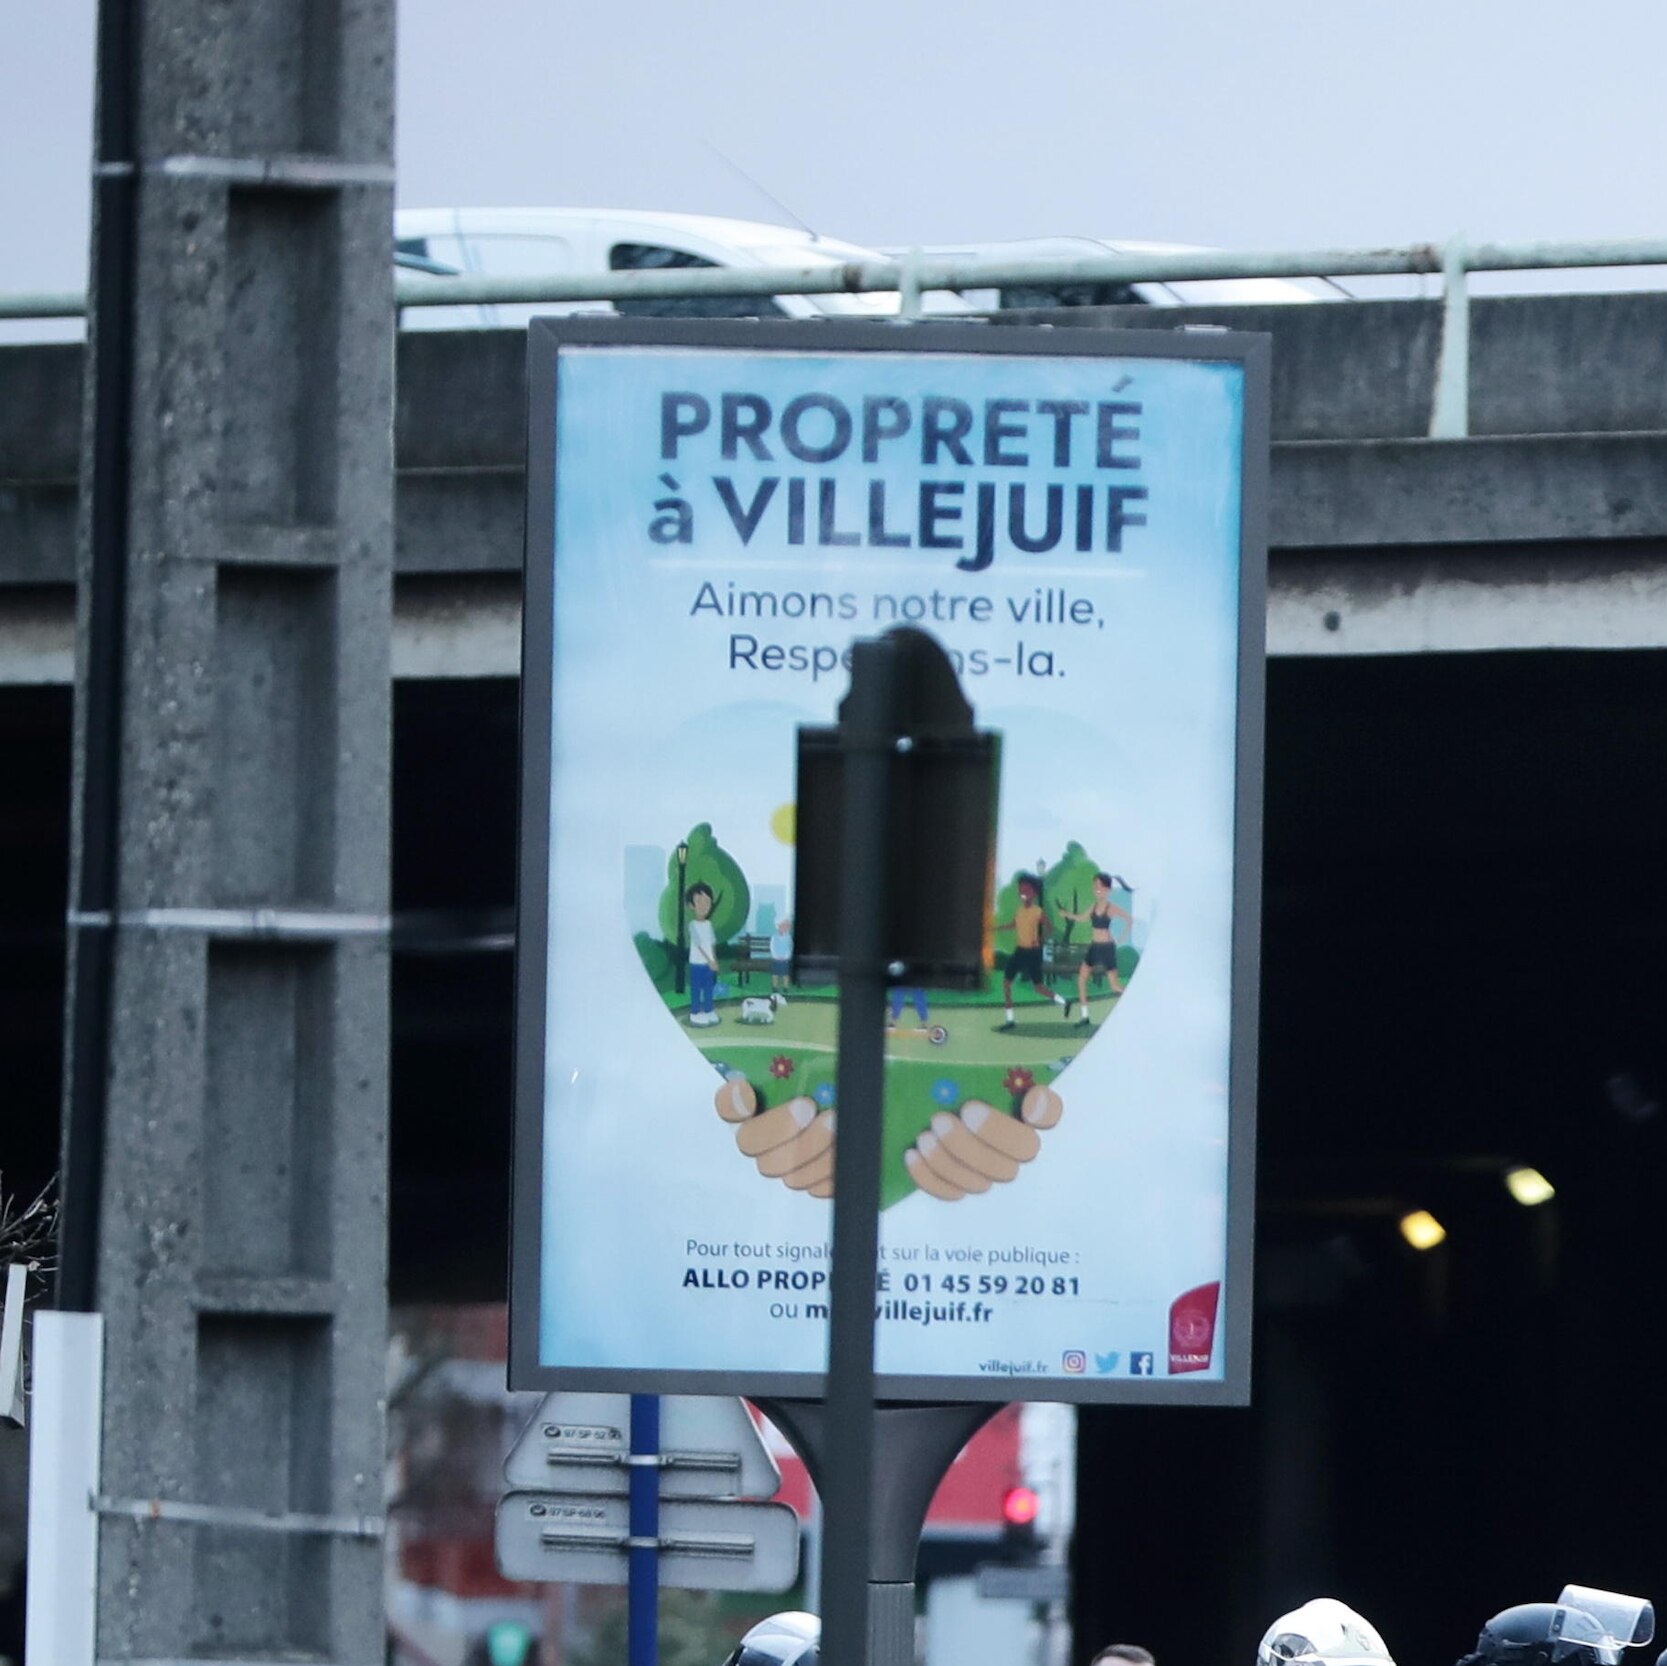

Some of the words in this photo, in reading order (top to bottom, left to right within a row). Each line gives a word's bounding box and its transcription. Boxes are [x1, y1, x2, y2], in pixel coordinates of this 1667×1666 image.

[660, 376, 1143, 470] PROPRETÉ
[648, 474, 694, 544] à
[712, 476, 1149, 571] VILLEJUIF
[690, 581, 857, 618] Aimons
[873, 589, 993, 622] notre
[1007, 588, 1104, 629] ville,
[686, 1240, 728, 1257] Pour
[734, 1242, 771, 1258] tout
[893, 1246, 918, 1261] sur
[925, 1244, 939, 1261] la
[946, 1246, 983, 1261] voie
[988, 1246, 1069, 1264] publique
[682, 1268, 749, 1289] ALLO
[757, 1268, 890, 1291] PROPÉ
[905, 1274, 931, 1293] 01
[941, 1274, 970, 1293] 45
[978, 1275, 1007, 1294] 59
[1015, 1276, 1044, 1295] 20
[1052, 1277, 1080, 1295] 81
[770, 1304, 798, 1318] ou
[978, 1361, 1048, 1375] villejuif.fr
